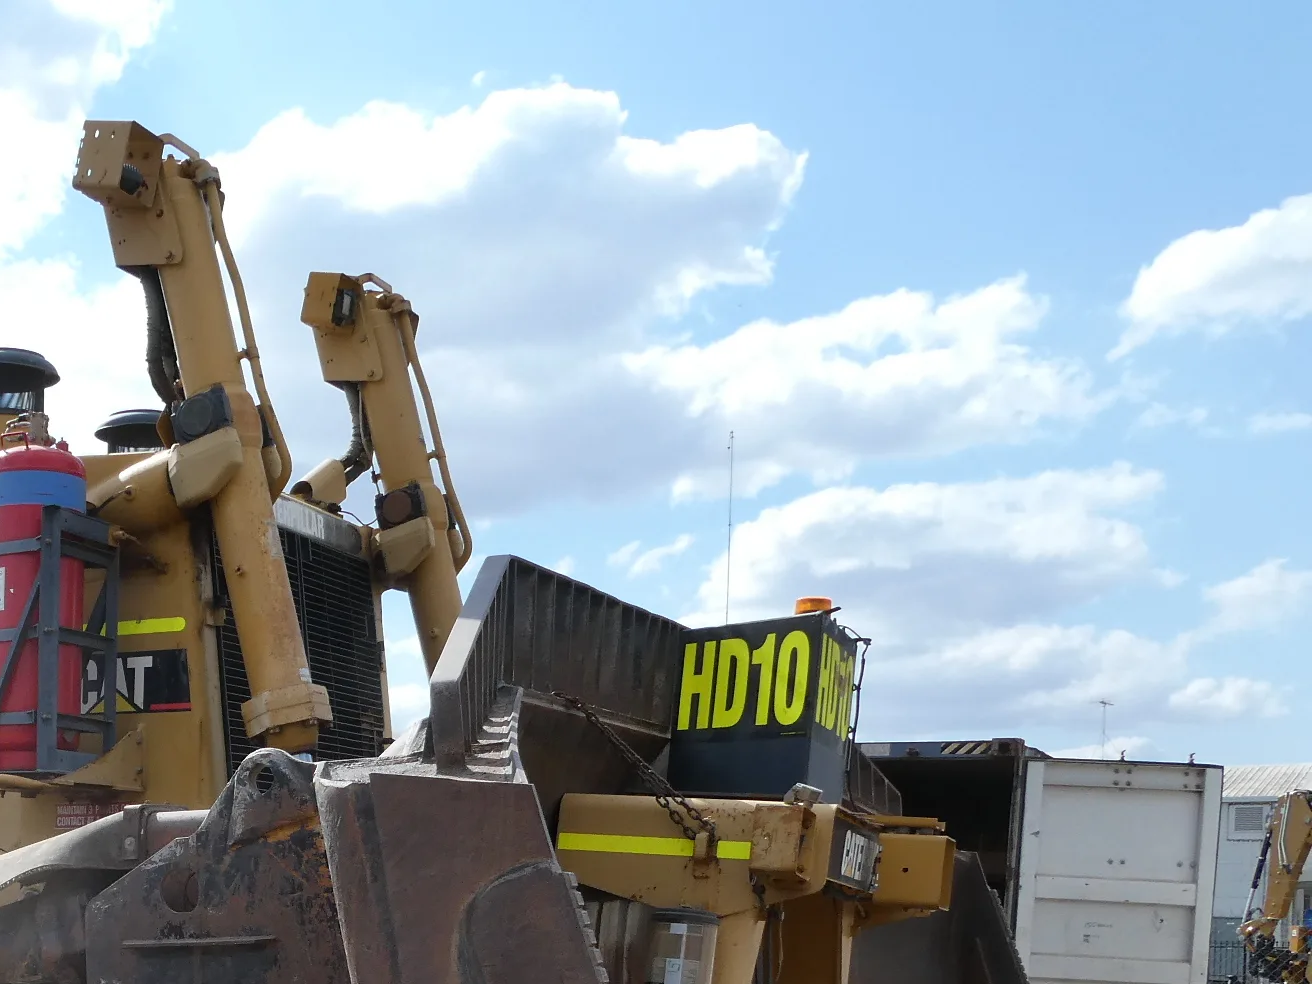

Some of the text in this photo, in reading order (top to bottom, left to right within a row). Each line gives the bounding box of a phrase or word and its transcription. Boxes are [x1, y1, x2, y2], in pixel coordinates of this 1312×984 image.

[81, 656, 153, 714] CAT
[677, 630, 810, 731] HD10
[815, 633, 856, 742] HD10
[57, 804, 87, 815] MAINTAIN
[57, 816, 85, 826] CONTACT
